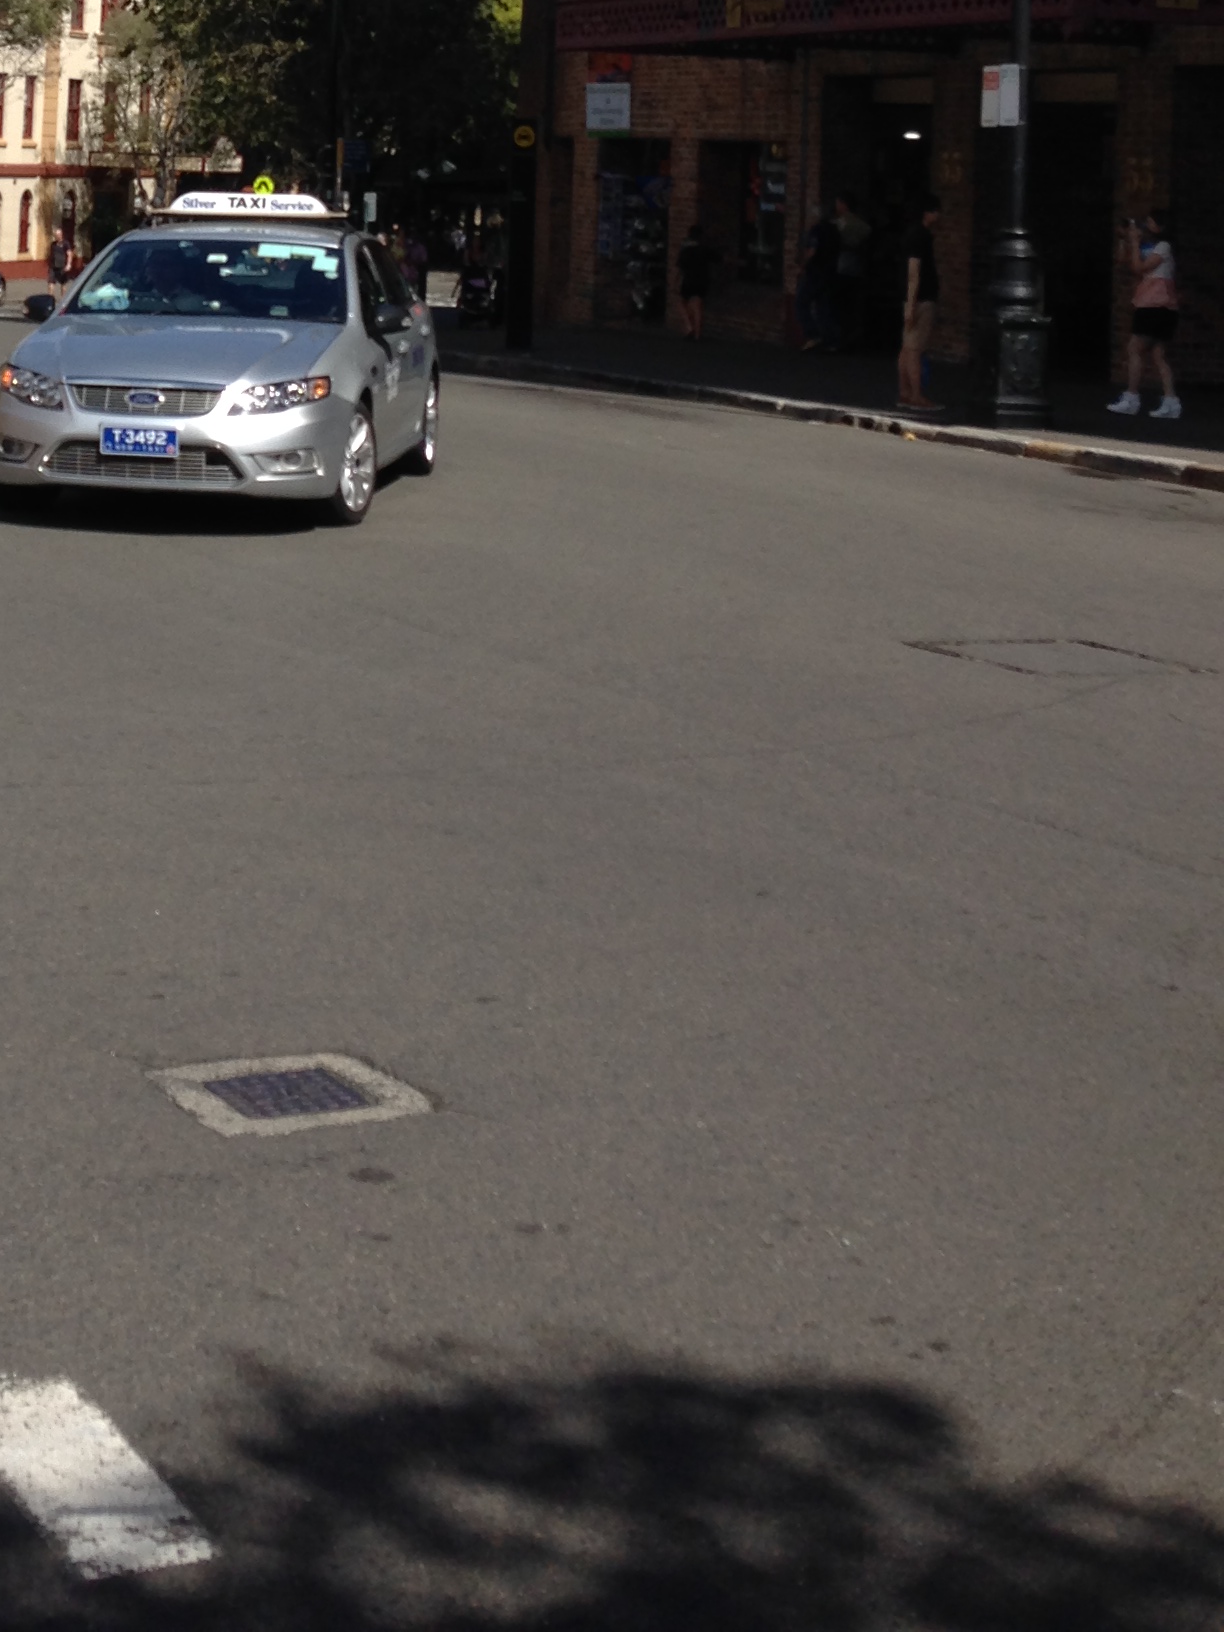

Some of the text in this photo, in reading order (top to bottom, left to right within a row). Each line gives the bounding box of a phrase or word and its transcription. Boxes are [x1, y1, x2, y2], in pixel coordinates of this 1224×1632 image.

[182, 197, 314, 211] Silver TAXI Service
